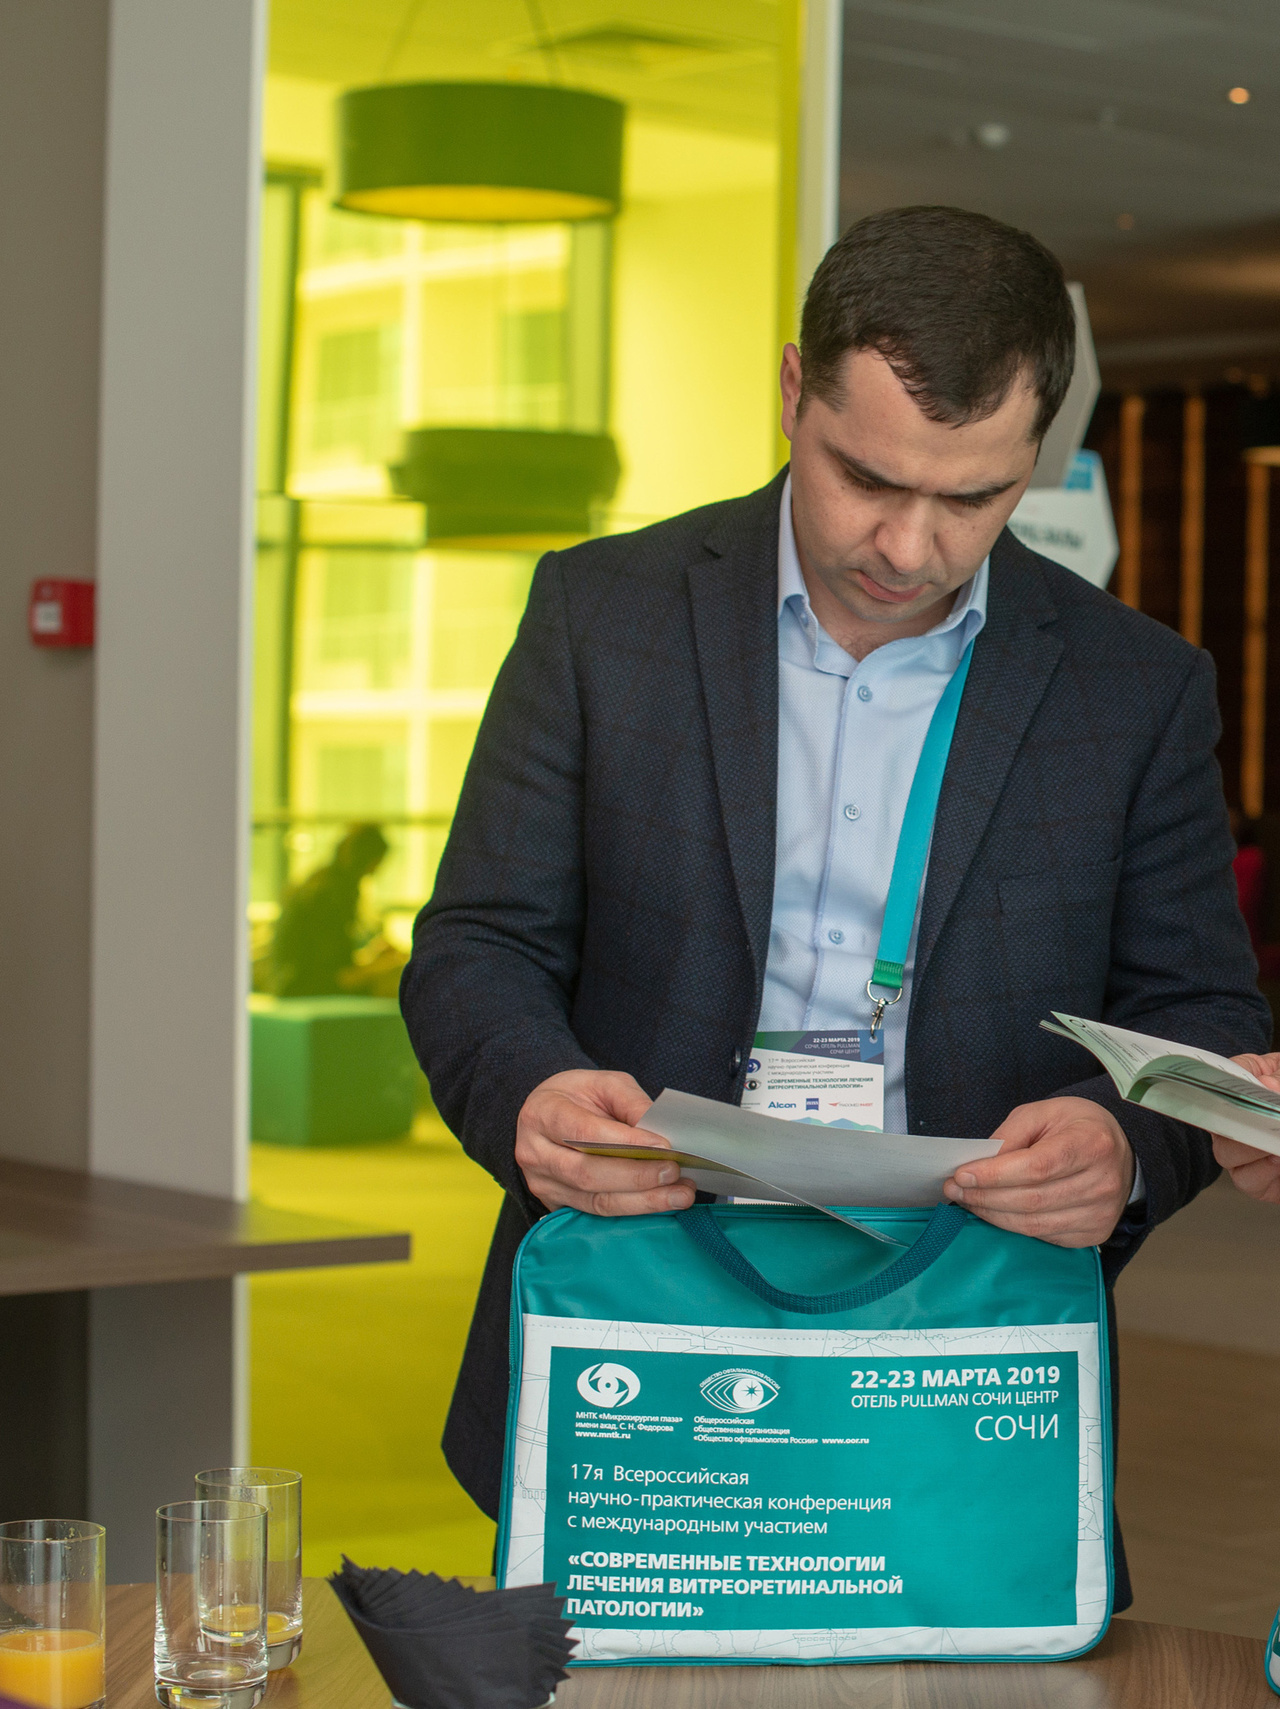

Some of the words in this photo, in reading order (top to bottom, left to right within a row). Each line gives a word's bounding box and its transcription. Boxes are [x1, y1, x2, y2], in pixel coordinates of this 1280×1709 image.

[850, 1370, 916, 1389] 22-23
[922, 1368, 1002, 1388] МАРТА
[1006, 1366, 1060, 1386] 2019
[851, 1394, 897, 1408] ОТЕЛЬ
[901, 1393, 969, 1408] PULLMAN
[972, 1392, 1012, 1406] СОЧИ
[1015, 1390, 1060, 1406] ЦЕНТР
[576, 1411, 598, 1420] МНТК
[598, 1412, 659, 1424] «Микрохирургия
[600, 1423, 617, 1431] акад.
[637, 1423, 674, 1432] Федорова
[694, 1416, 755, 1425] Общероссийская
[575, 1430, 631, 1439] www.mntk.ru
[693, 1426, 744, 1434] общественная
[745, 1428, 790, 1436] организация
[974, 1414, 1059, 1442] СОЧИ
[693, 1434, 733, 1443] «Общество
[734, 1435, 789, 1444] офтальмологов
[571, 1463, 603, 1481] 17я
[613, 1465, 749, 1487] Всероссийская
[568, 1490, 763, 1511] научно-практическая
[768, 1494, 892, 1514] конференция
[567, 1515, 577, 1528] с
[581, 1514, 739, 1535] международным
[744, 1520, 828, 1537] участием
[568, 1551, 742, 1571] «СОВРЕМЕННЫЕ
[746, 1555, 886, 1572] ТЕХНОЛОГИИ
[567, 1574, 664, 1594] ЛЕЧЕНИЯ
[669, 1574, 904, 1594] ВИТРЕОРЕТИНАЛЬНОЙ
[567, 1598, 704, 1618] ПАТОЛОГИИ»
